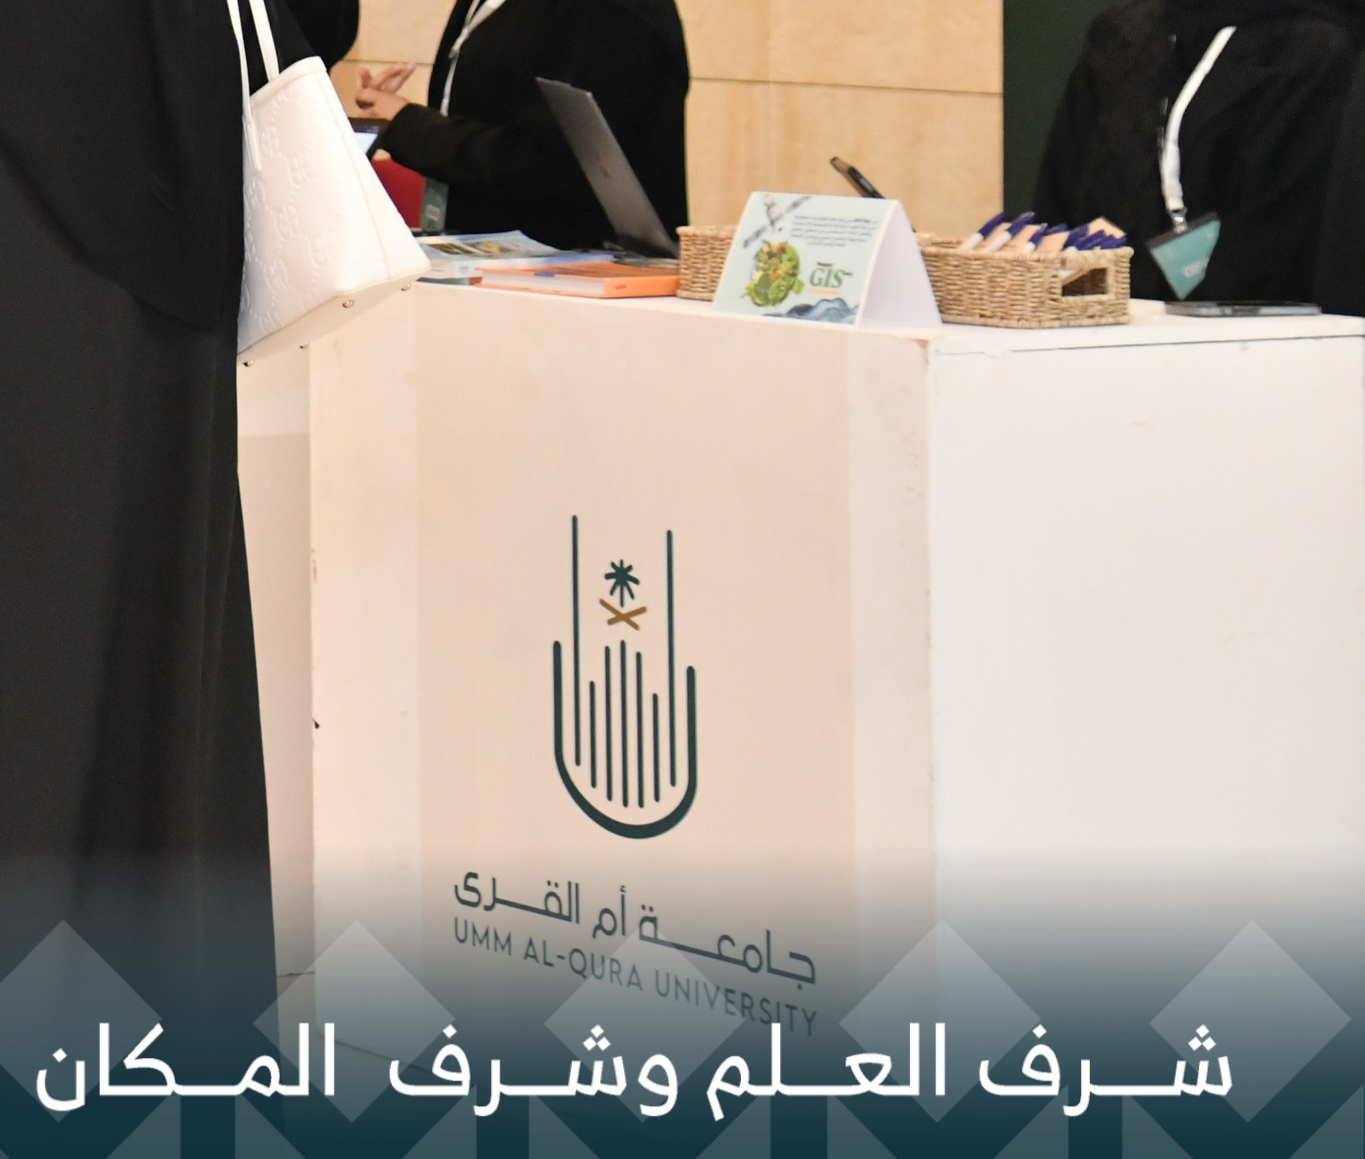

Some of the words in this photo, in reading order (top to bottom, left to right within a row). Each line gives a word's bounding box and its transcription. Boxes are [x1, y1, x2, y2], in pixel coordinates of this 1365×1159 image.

[809, 267, 844, 289] GIS
[454, 871, 581, 925] القرى
[592, 884, 627, 940] أم
[639, 903, 816, 991] جامعة
[454, 916, 513, 957] UMM
[523, 937, 644, 993] AL-QURA
[655, 970, 818, 1037] UNIVERSITY
